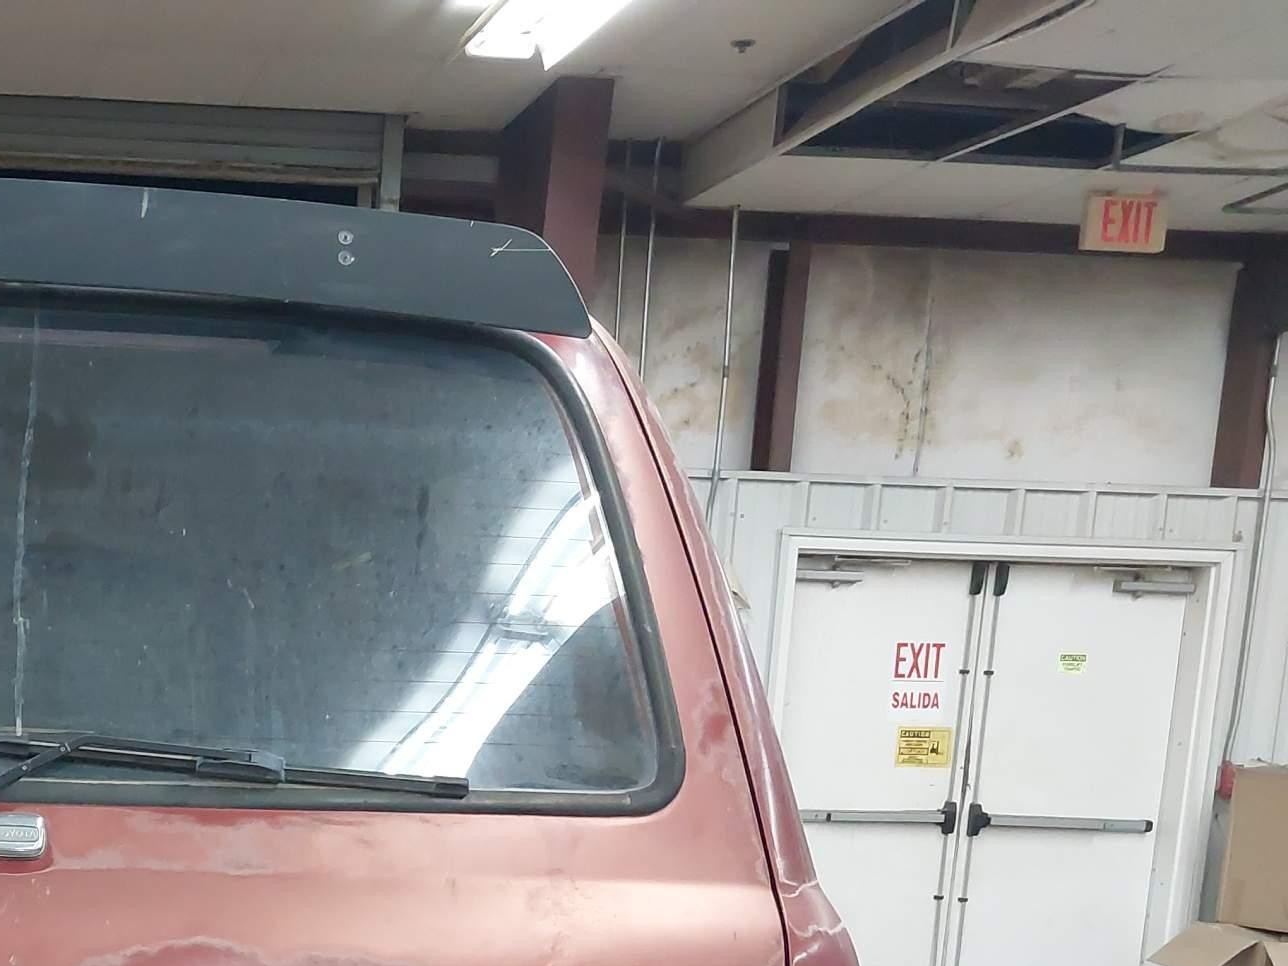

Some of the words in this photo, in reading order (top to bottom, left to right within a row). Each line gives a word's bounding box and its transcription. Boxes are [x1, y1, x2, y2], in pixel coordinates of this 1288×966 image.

[1102, 200, 1158, 243] EXIT
[894, 643, 946, 678] EXIT
[892, 692, 939, 709] SALIDA
